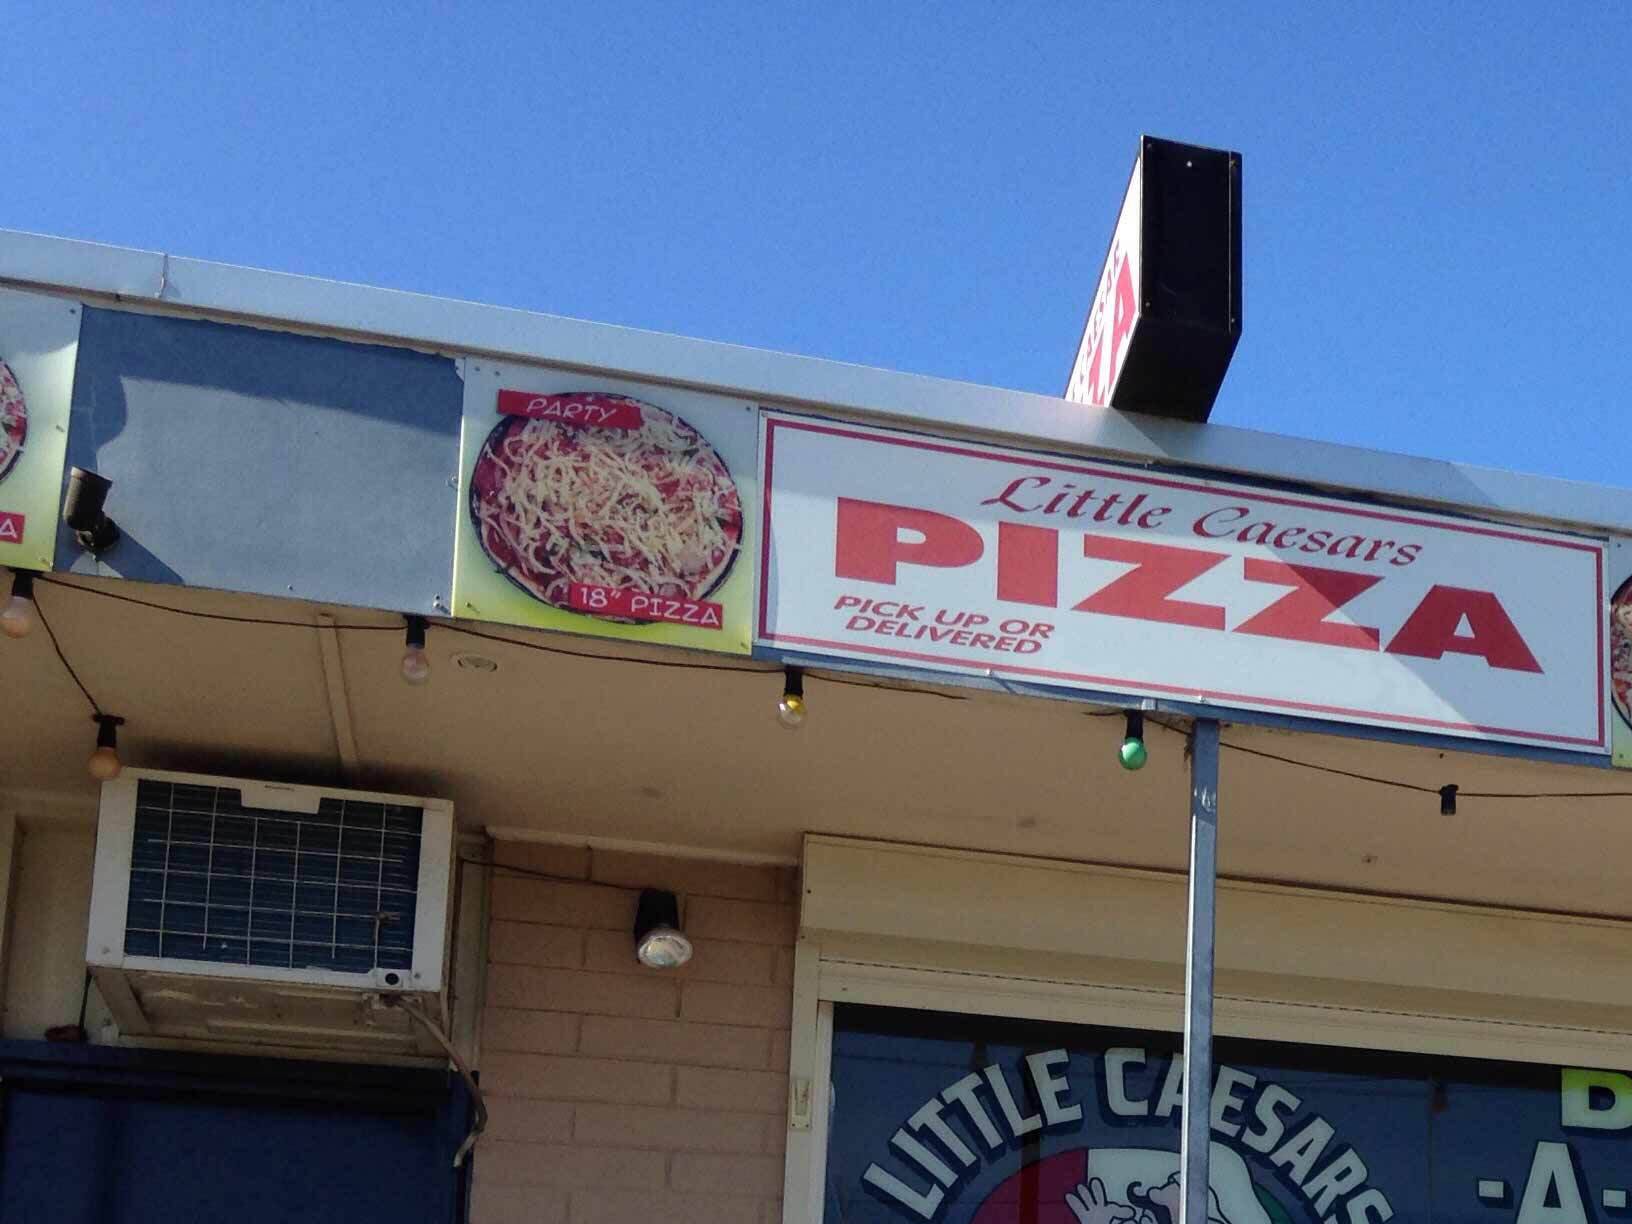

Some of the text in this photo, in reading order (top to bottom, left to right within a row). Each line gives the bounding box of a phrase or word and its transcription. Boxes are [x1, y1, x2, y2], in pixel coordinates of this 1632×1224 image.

[526, 397, 617, 423] PARTY
[981, 475, 1424, 569] Little Caesars
[834, 497, 1544, 674] PIZZA
[630, 596, 720, 626] PIZZA
[833, 595, 1055, 639] PICK UP OR
[846, 615, 1042, 654] DELIVERED
[863, 1047, 1083, 1221] LITTLE
